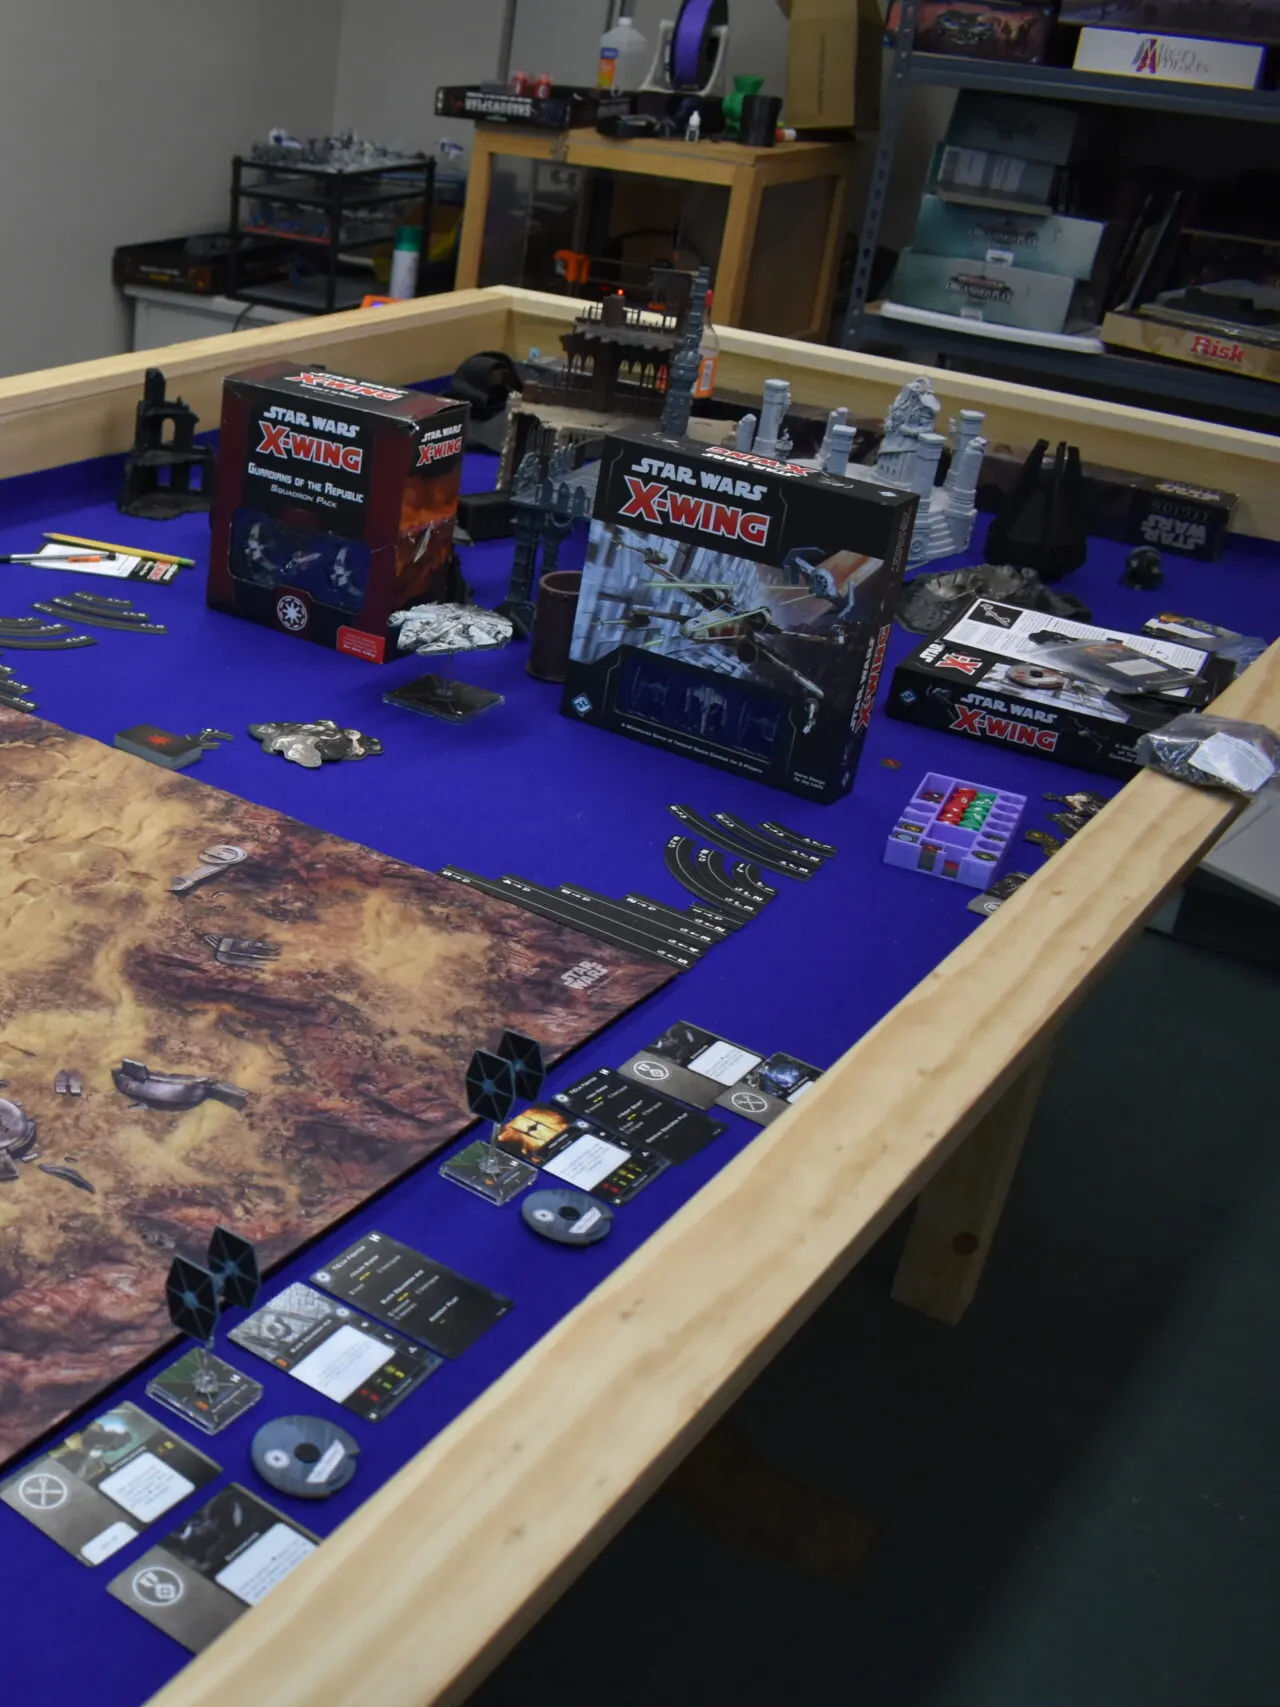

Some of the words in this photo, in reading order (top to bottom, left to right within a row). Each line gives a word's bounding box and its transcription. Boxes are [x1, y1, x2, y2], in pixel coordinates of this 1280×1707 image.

[1190, 335, 1246, 362] Risk
[284, 372, 403, 401] X-WING
[263, 405, 310, 427] STAR
[312, 416, 360, 438] WARS
[421, 430, 442, 443] STAR
[442, 423, 463, 437] WARS
[255, 420, 363, 474] X-WING
[416, 436, 463, 467] X-WING
[631, 457, 697, 486] STAR
[700, 471, 768, 501] WARS
[618, 475, 771, 547] X-WING
[1140, 525, 1206, 550] STAR
[1141, 514, 1206, 540] WARS
[853, 624, 891, 734] X-WING
[960, 693, 1007, 712] STAR
[1010, 703, 1058, 724] WARS
[949, 703, 1060, 752] X-WING
[560, 960, 603, 981] STAR
[564, 968, 608, 990] WARS
